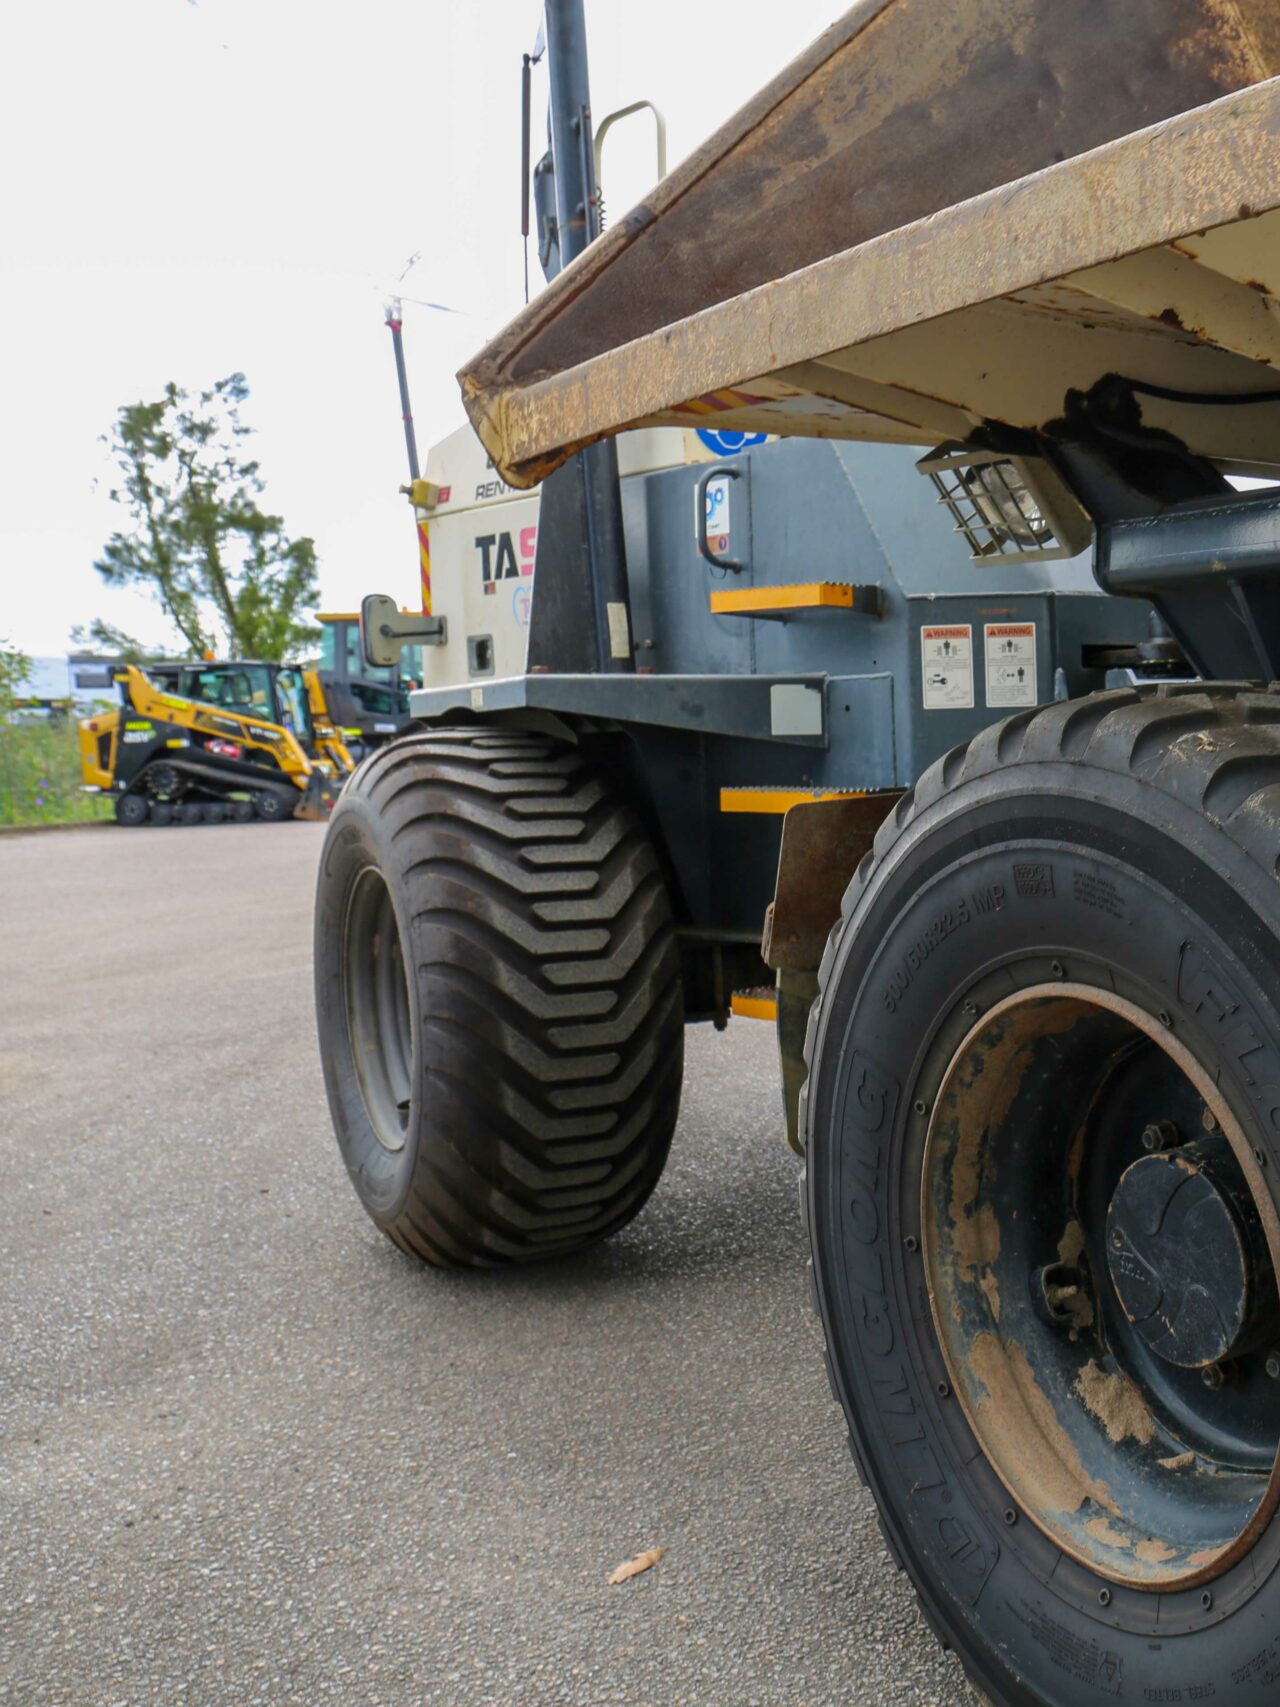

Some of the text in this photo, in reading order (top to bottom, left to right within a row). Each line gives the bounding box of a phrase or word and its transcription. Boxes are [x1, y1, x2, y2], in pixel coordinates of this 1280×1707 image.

[933, 629, 968, 638] WARNING
[997, 627, 1031, 635] WARNING
[972, 883, 1005, 915] IMP
[846, 1066, 948, 1492] LINGLONG
